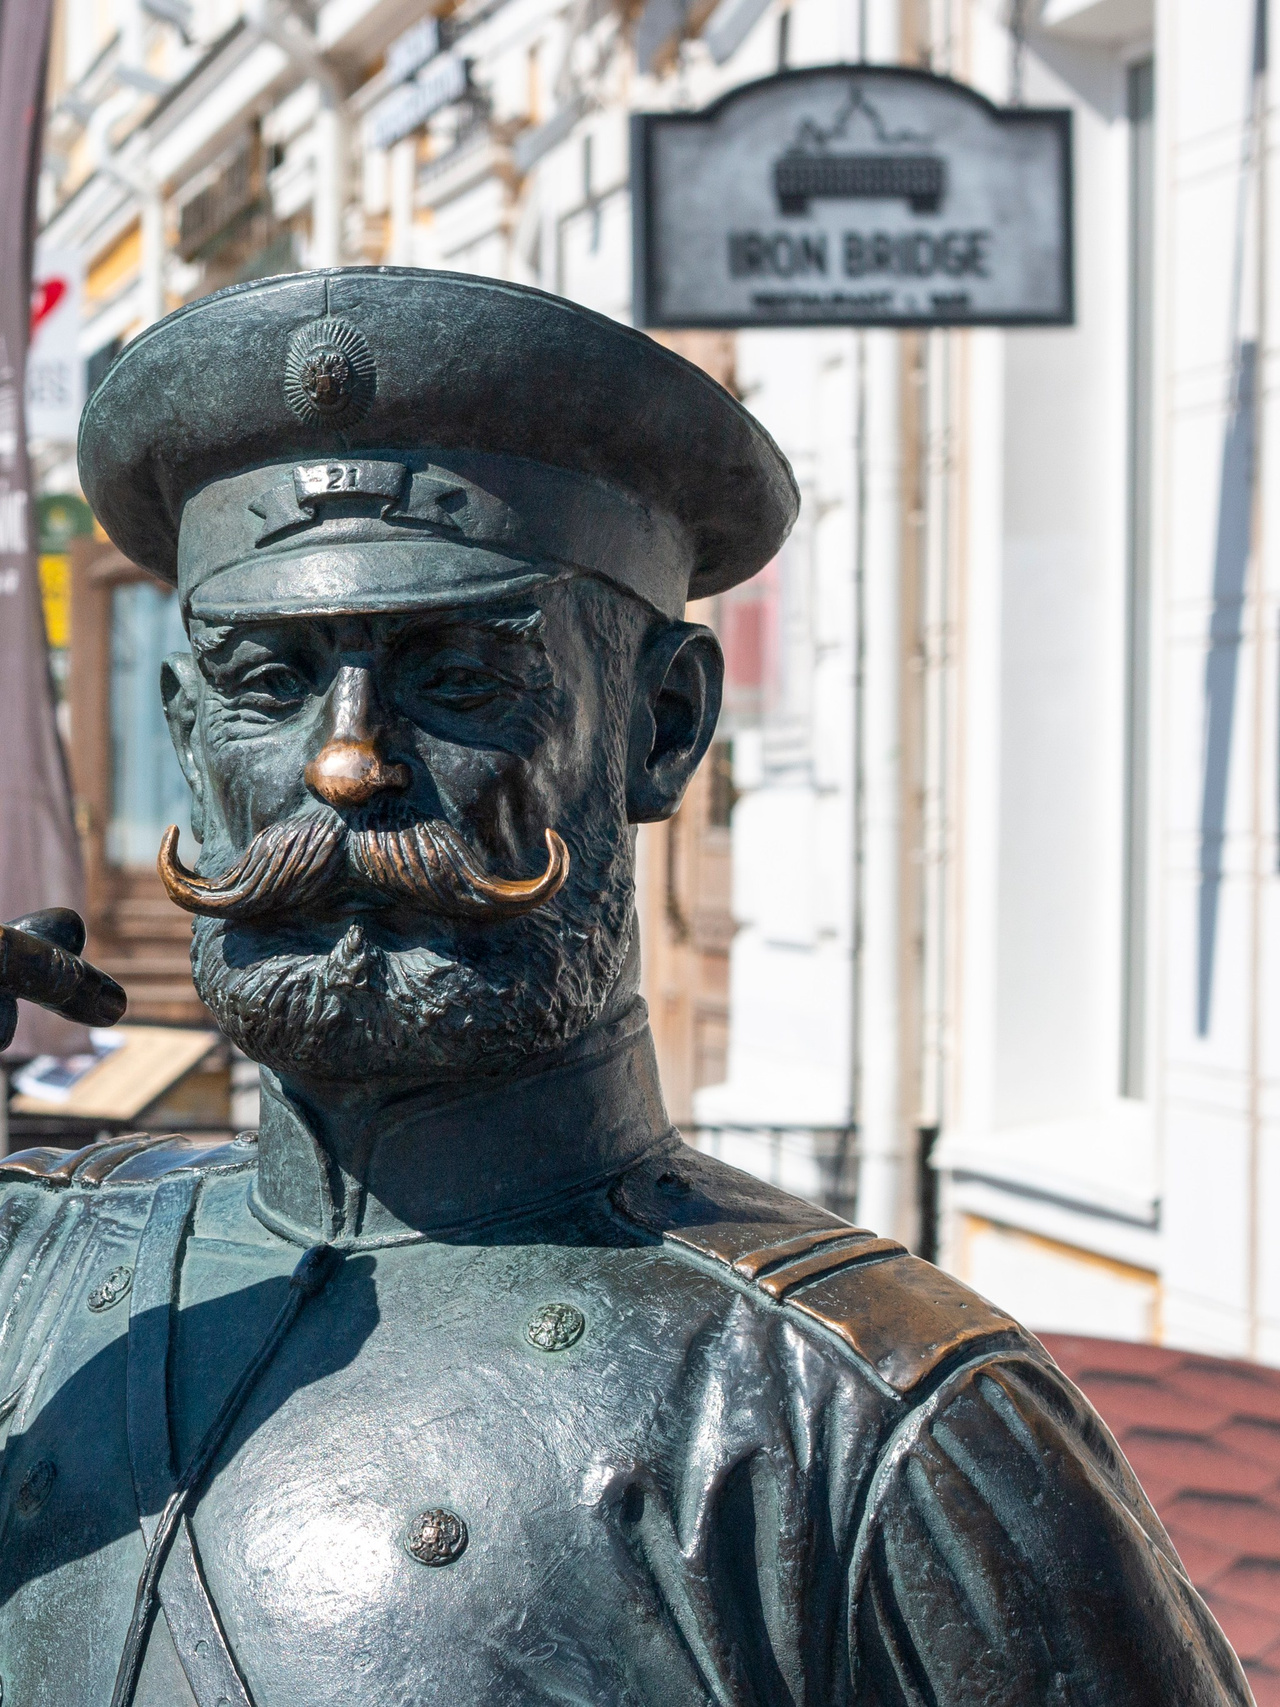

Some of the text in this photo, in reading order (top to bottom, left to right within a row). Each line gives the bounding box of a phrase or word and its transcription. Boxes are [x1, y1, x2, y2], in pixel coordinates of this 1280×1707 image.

[728, 228, 991, 279] IRON BRIDGE
[327, 465, 360, 490] 21
